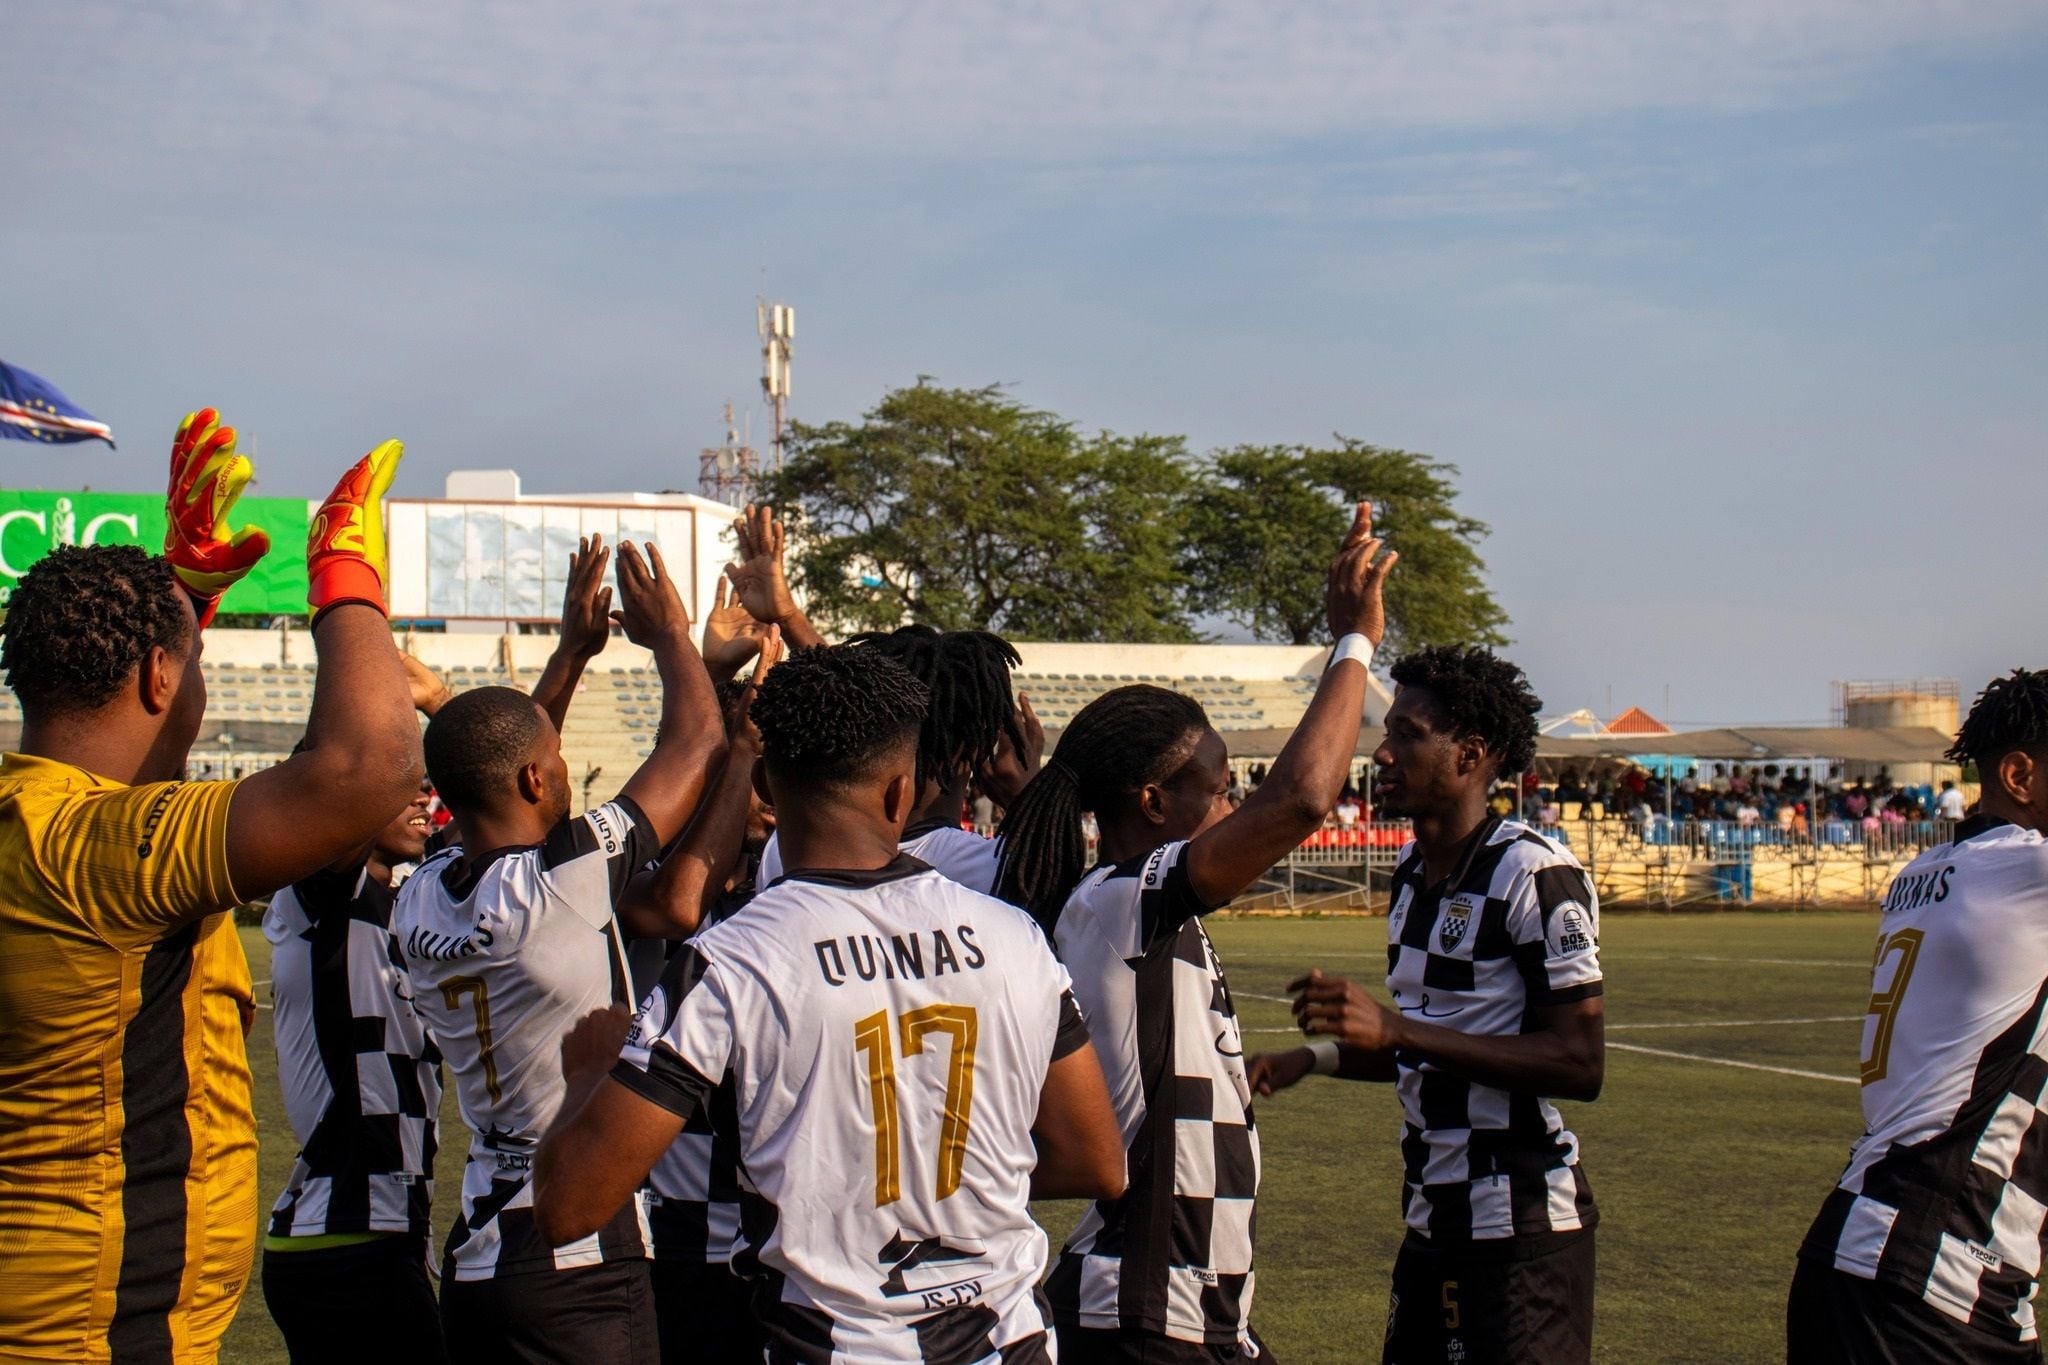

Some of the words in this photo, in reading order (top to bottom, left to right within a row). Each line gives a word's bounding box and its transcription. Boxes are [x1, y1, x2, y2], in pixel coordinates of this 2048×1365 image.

[813, 925, 986, 987] QUINAS
[442, 975, 502, 1107] 7
[854, 1003, 978, 1209] 17
[1443, 1281, 1460, 1329] 5
